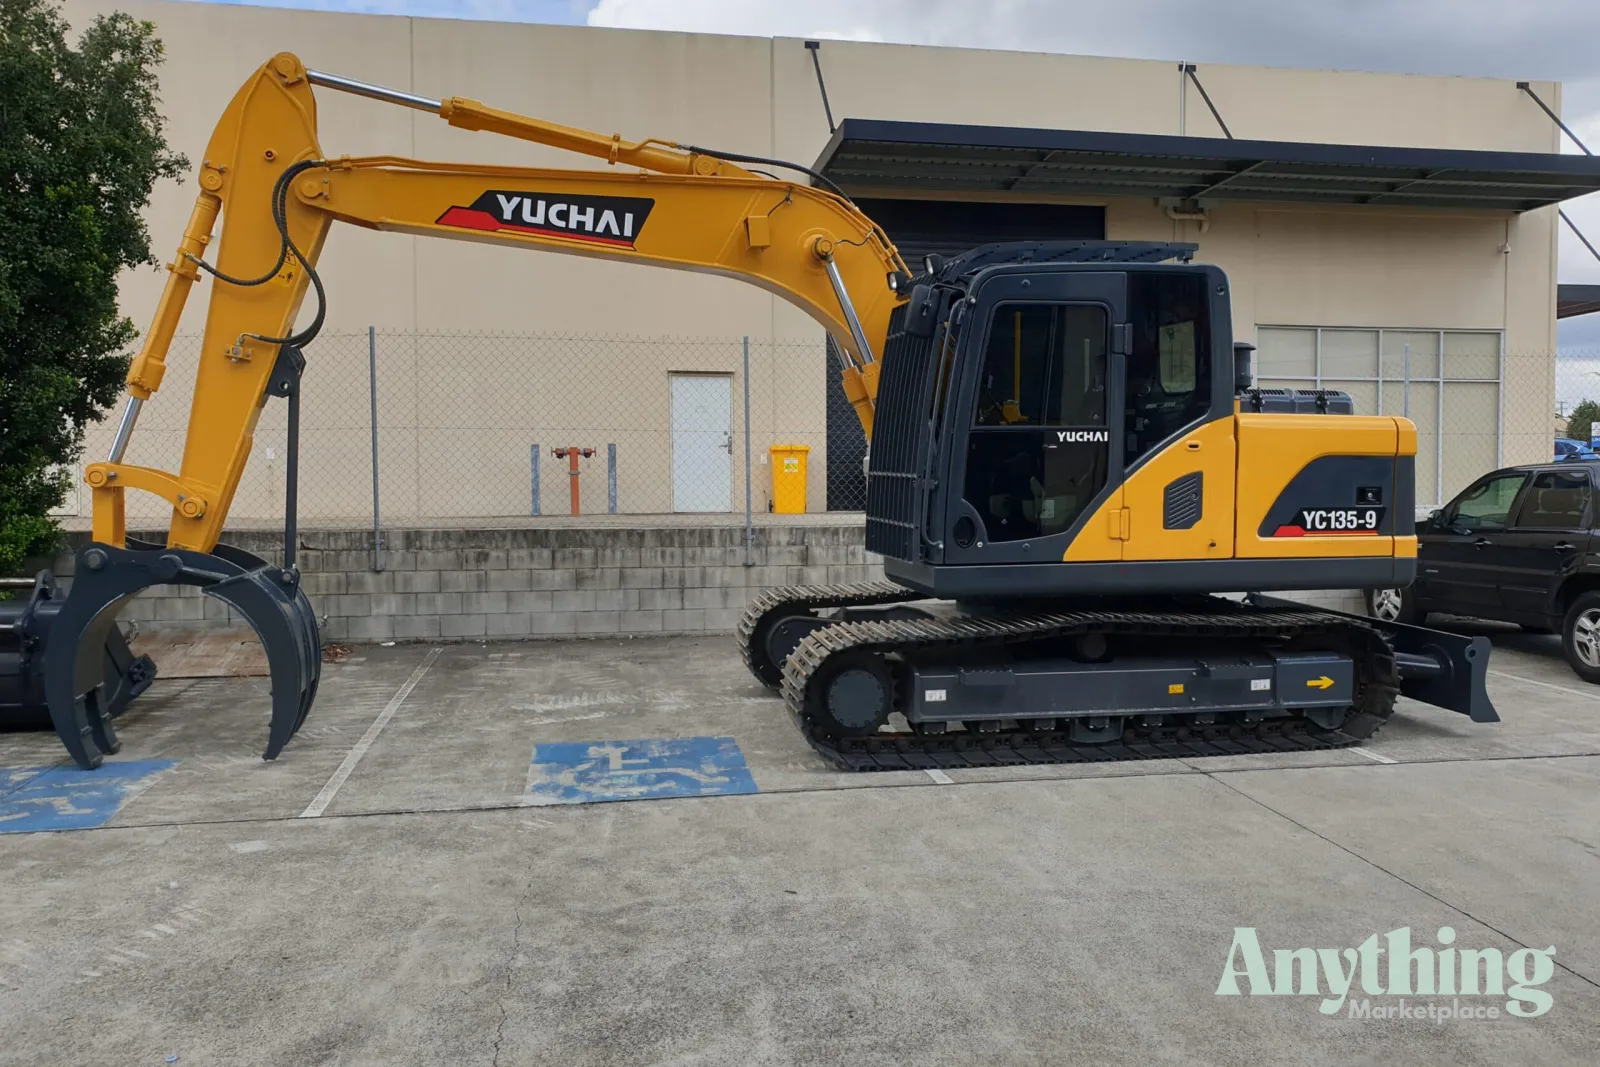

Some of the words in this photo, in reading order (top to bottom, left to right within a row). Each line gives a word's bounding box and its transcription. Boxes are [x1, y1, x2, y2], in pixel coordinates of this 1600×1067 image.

[496, 194, 634, 237] YUCHAI
[1056, 431, 1108, 442] YUCHAI
[1302, 510, 1377, 530] YC135-9
